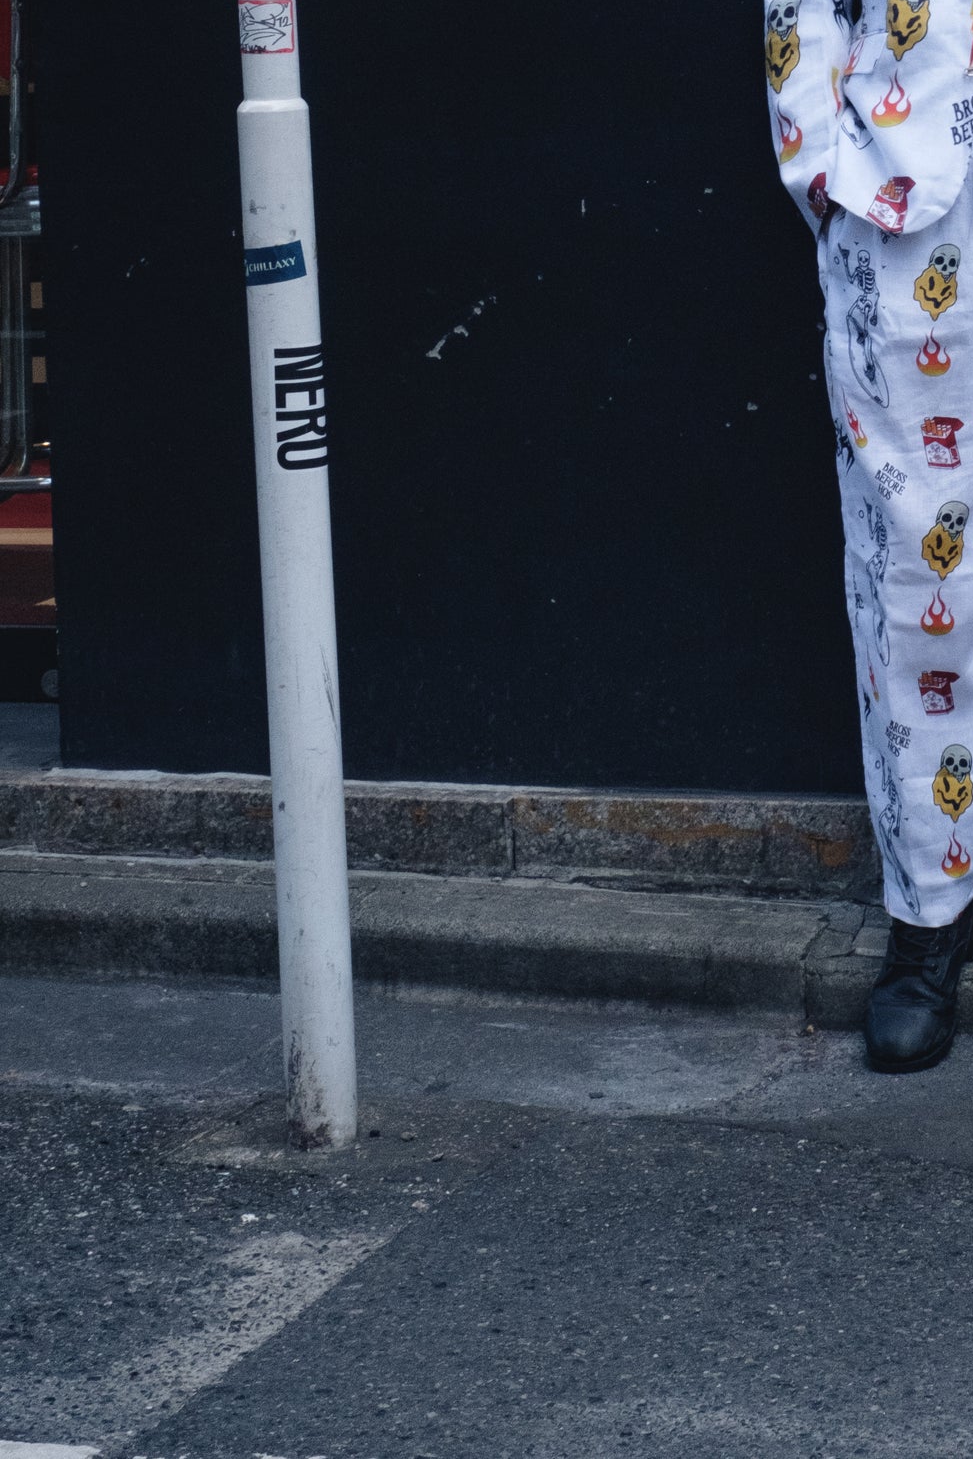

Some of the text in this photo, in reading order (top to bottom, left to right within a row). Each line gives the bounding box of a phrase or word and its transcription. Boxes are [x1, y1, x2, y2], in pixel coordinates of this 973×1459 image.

[249, 256, 296, 272] CHILLAXY
[875, 469, 906, 495] BEFORE
[883, 461, 908, 484] BROSS
